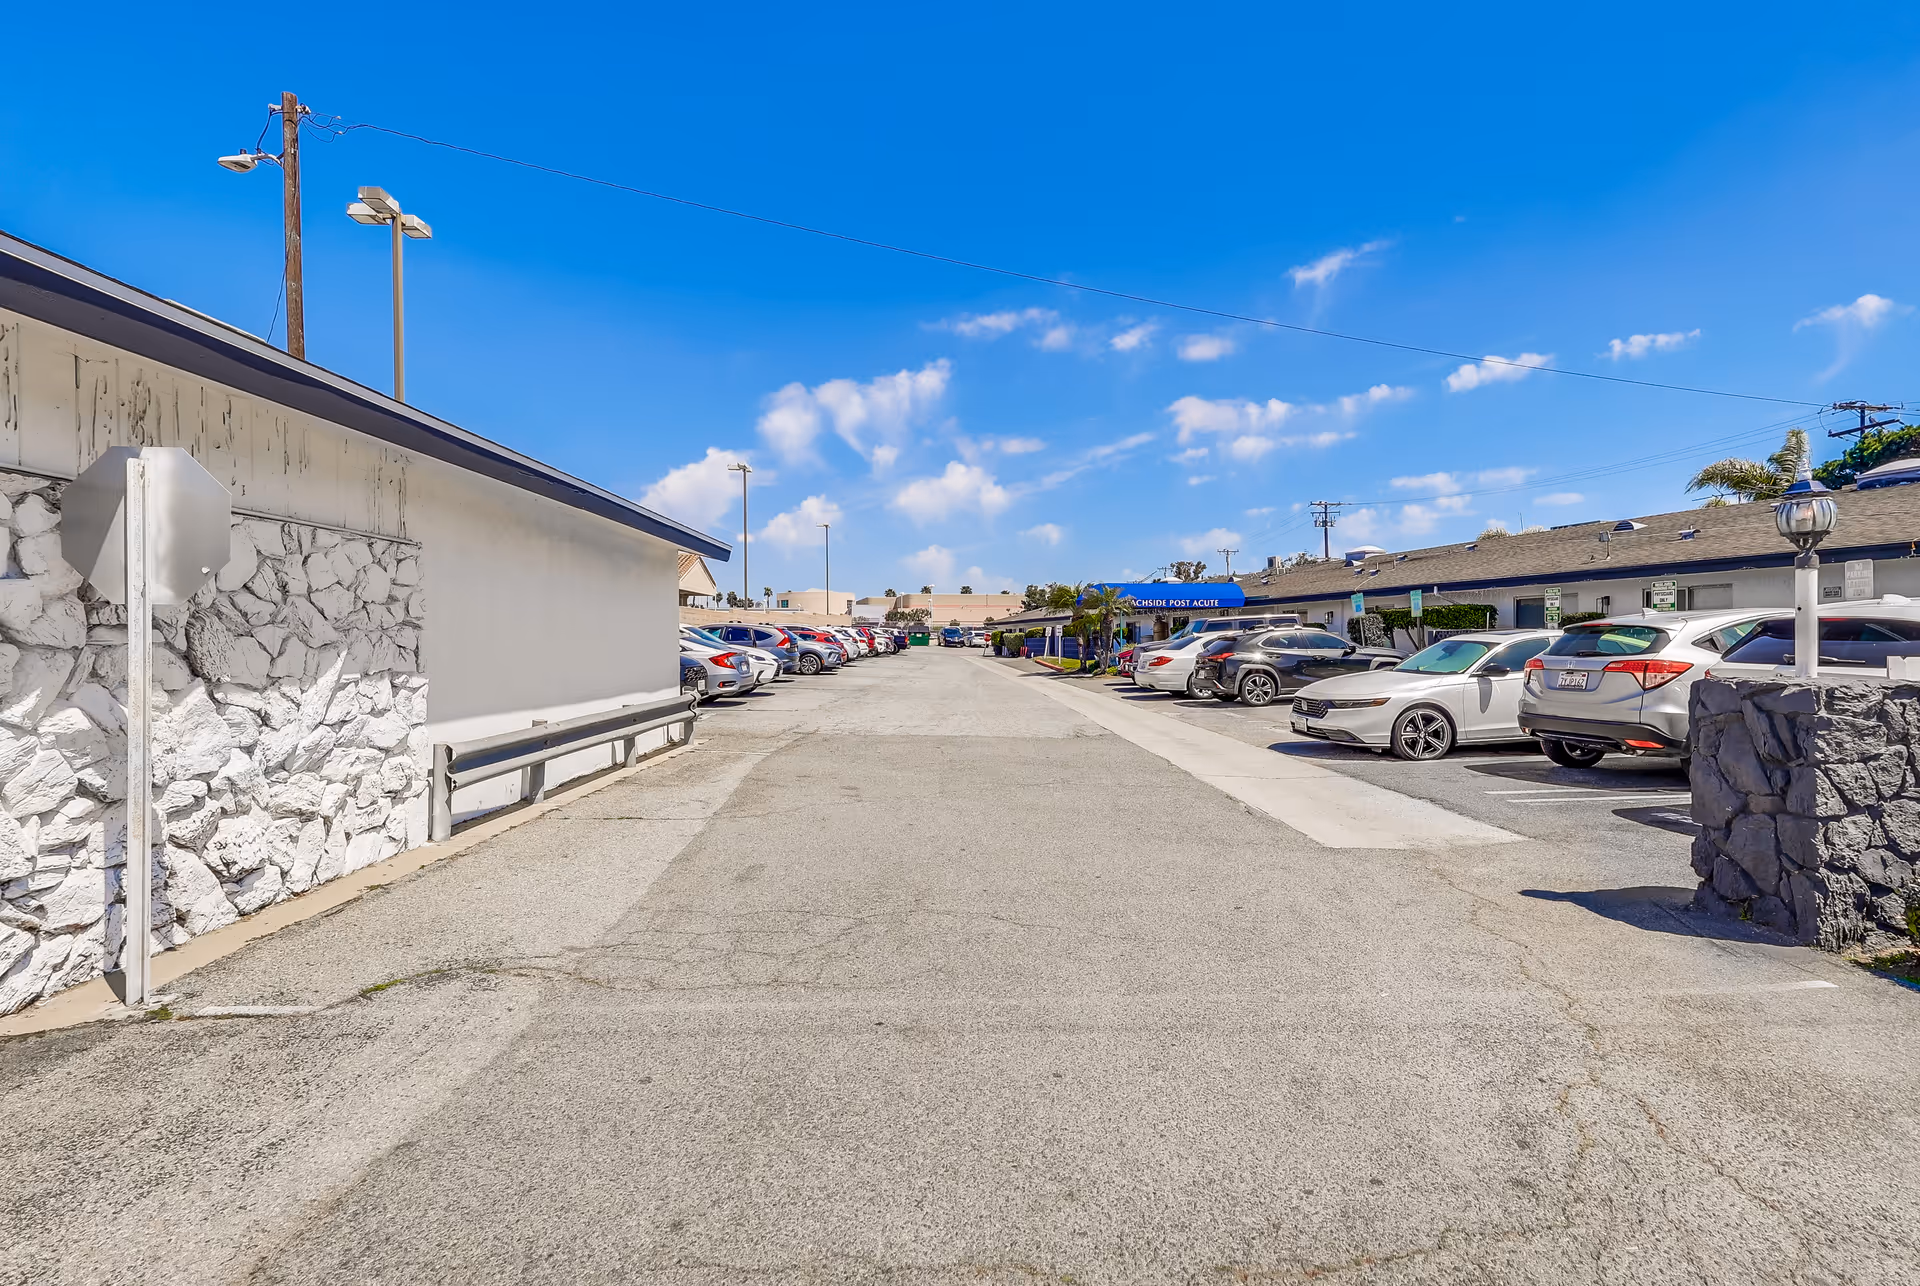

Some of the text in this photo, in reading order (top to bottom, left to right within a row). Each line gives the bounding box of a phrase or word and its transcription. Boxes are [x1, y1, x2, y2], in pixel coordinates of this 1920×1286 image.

[1131, 599, 1219, 607] ACHSIDE POST ACUTE
